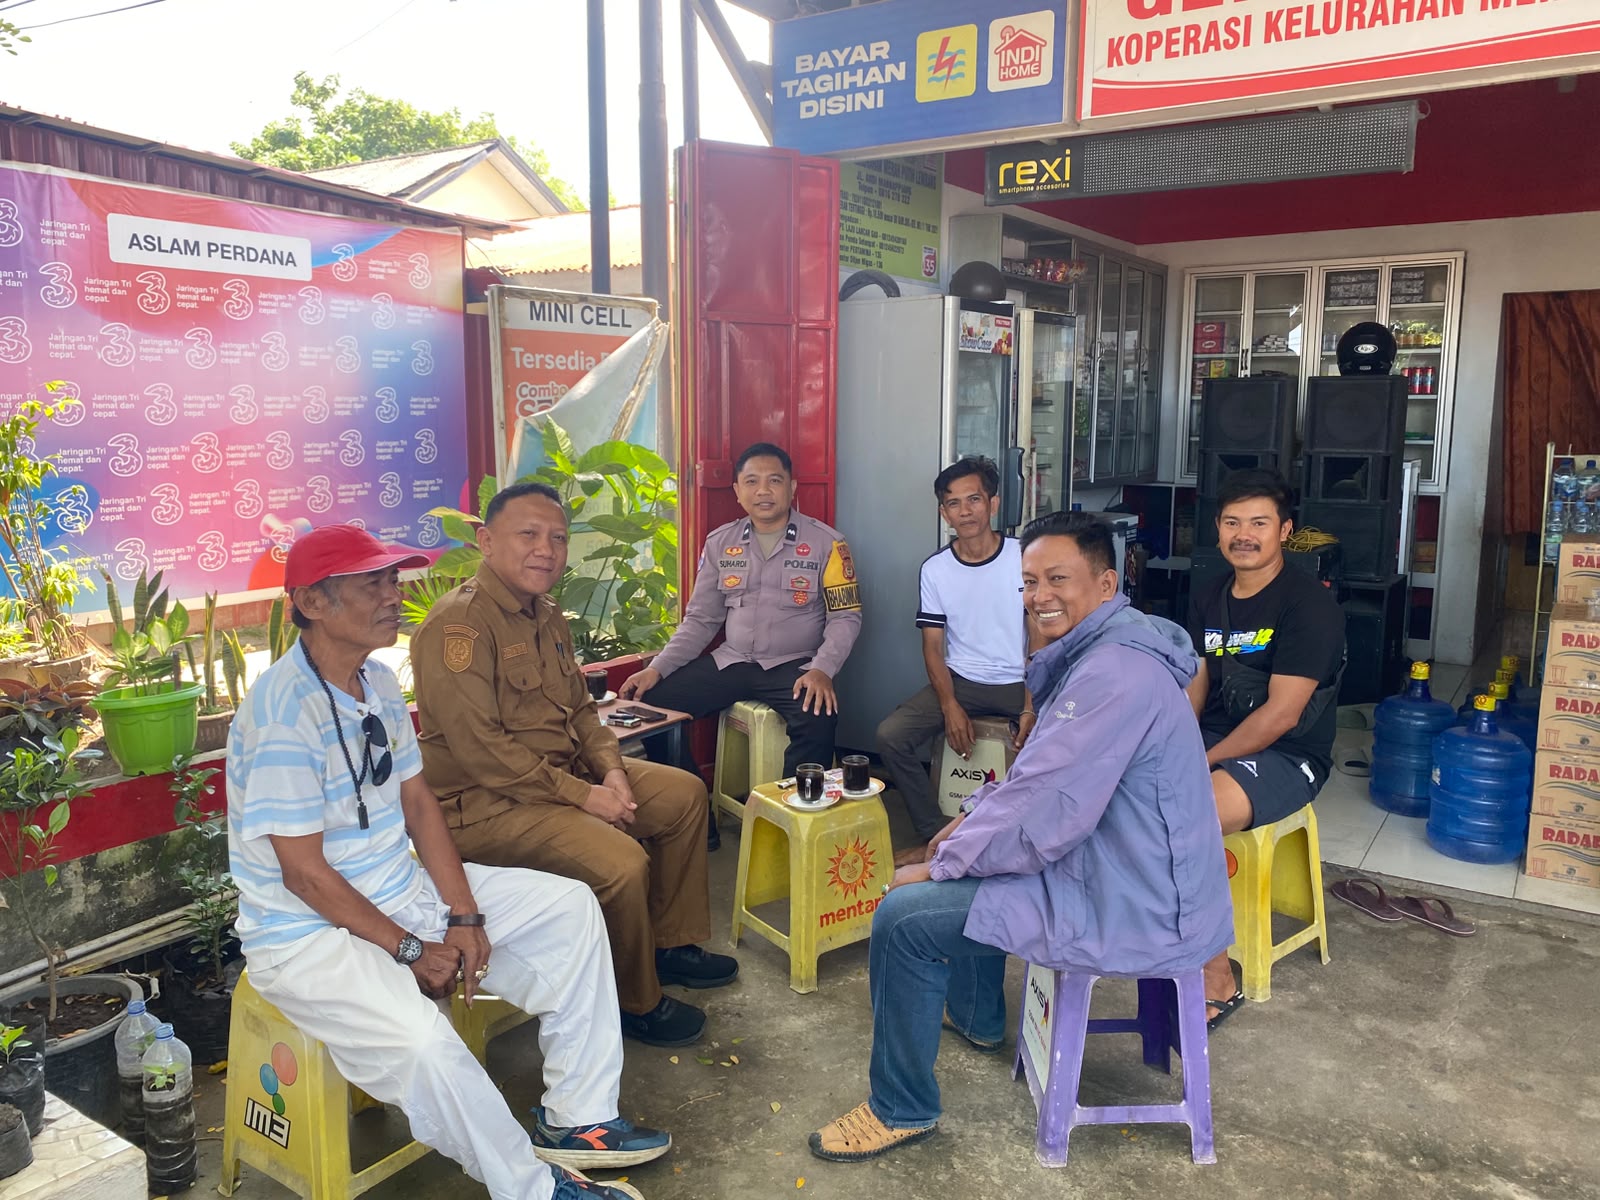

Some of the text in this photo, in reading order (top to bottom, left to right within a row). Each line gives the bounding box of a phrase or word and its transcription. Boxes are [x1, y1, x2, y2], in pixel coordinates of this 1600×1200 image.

[1107, 15, 1252, 68] KOPERASI
[795, 40, 890, 74] BAYAR
[1000, 46, 1040, 66] INDI
[1000, 64, 1040, 80] HOME
[781, 61, 906, 98] TAGIHAN
[800, 89, 884, 119] DISINI
[999, 148, 1071, 187] rexi
[40, 219, 91, 231] Jaringan Tri
[41, 228, 86, 240] hemat dan
[128, 233, 298, 268] ASLAM PERDANA
[16, 271, 28, 279] Tri
[5, 279, 22, 287] dan
[83, 277, 132, 288] Jaringan Tri
[84, 286, 127, 296] hemat dan
[176, 284, 219, 295] Jaringan Tri
[177, 292, 215, 302] hemat dan
[529, 301, 632, 328] MINI CELL
[48, 333, 85, 343] Jaringan
[49, 341, 93, 351] hemat dan
[510, 347, 596, 371] Tersedia
[518, 382, 569, 399] Combo
[92, 392, 139, 402] Jaringan Tri
[93, 402, 135, 410] hemat dan
[57, 446, 107, 457] Jaringan Tri
[146, 445, 190, 456] Jaringan Tri
[86, 456, 101, 464] dan
[147, 453, 186, 463] hemat dan
[189, 491, 220, 501] Jaringan
[100, 496, 146, 509] Jaringan Tri
[190, 500, 211, 509] hemat
[100, 504, 142, 517] hemat dan
[231, 538, 271, 550] Jaringan Tri
[152, 545, 196, 558] Jaringan Tri
[231, 548, 251, 557] hemat
[154, 553, 192, 564] hemat dan
[719, 559, 819, 571] SUHARDI POLRI
[950, 768, 982, 781] AXIS
[245, 1098, 290, 1148] IM3
